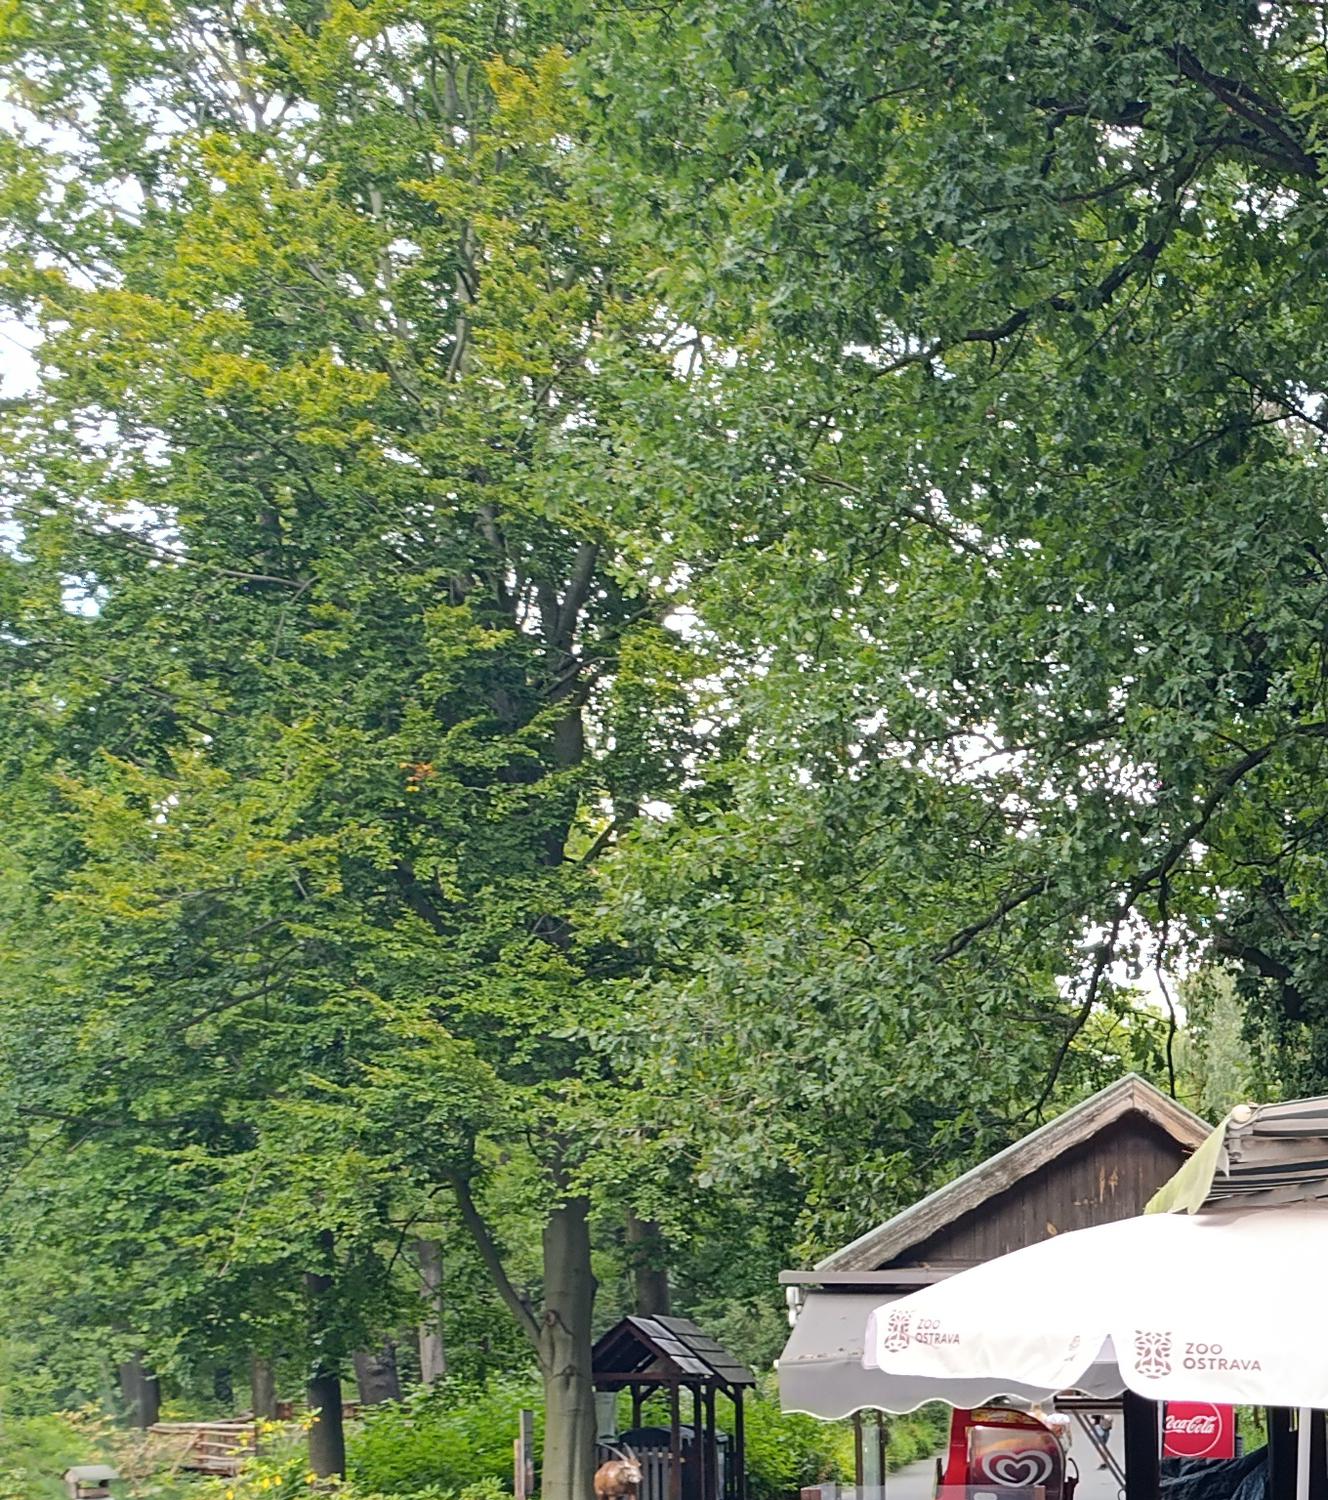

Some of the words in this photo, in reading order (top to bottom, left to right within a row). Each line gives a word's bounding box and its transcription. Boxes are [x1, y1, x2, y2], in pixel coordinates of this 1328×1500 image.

[917, 1318, 941, 1330] ZOO
[915, 1332, 960, 1345] OSTRAVA
[1185, 1342, 1223, 1355] ZOO
[1183, 1357, 1261, 1371] OSTRAVA
